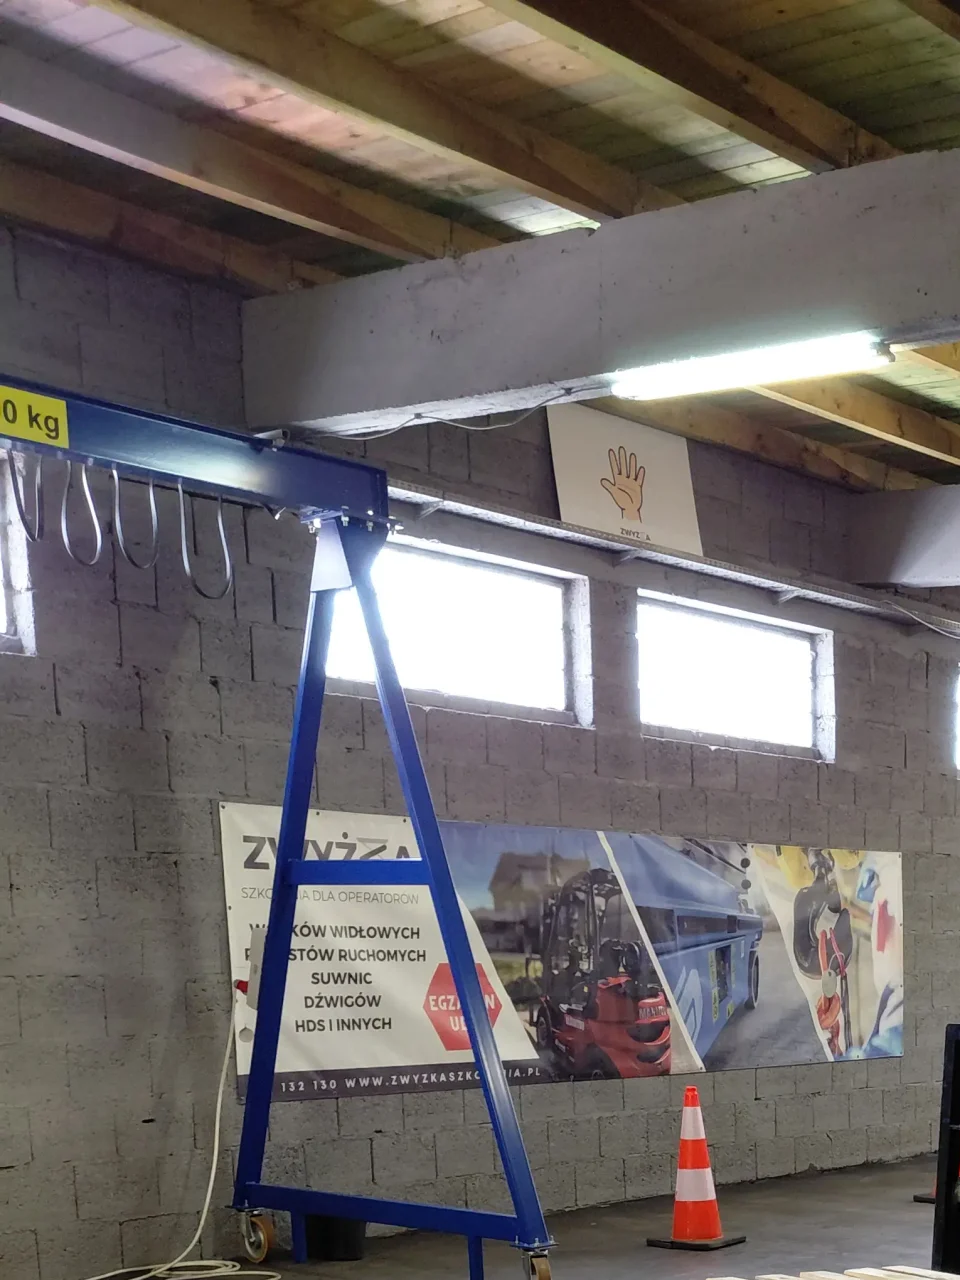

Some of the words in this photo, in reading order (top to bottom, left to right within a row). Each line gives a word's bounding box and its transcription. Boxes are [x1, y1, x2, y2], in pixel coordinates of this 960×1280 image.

[28, 404, 60, 440] kg
[241, 887, 309, 901] SZKOIA
[313, 890, 336, 902] DLA
[338, 891, 419, 904] OPERATORÓW
[330, 925, 420, 939] WIDŁOWYCH
[339, 949, 426, 962] RUCHOMYCH
[311, 972, 372, 985] SUWNIC
[304, 992, 381, 1009] DŹWIGÓW
[295, 1019, 326, 1032] HDS
[329, 1019, 333, 1032] I
[336, 1017, 392, 1031] INNYCH
[281, 1081, 305, 1092] 132
[313, 1080, 336, 1091] 130
